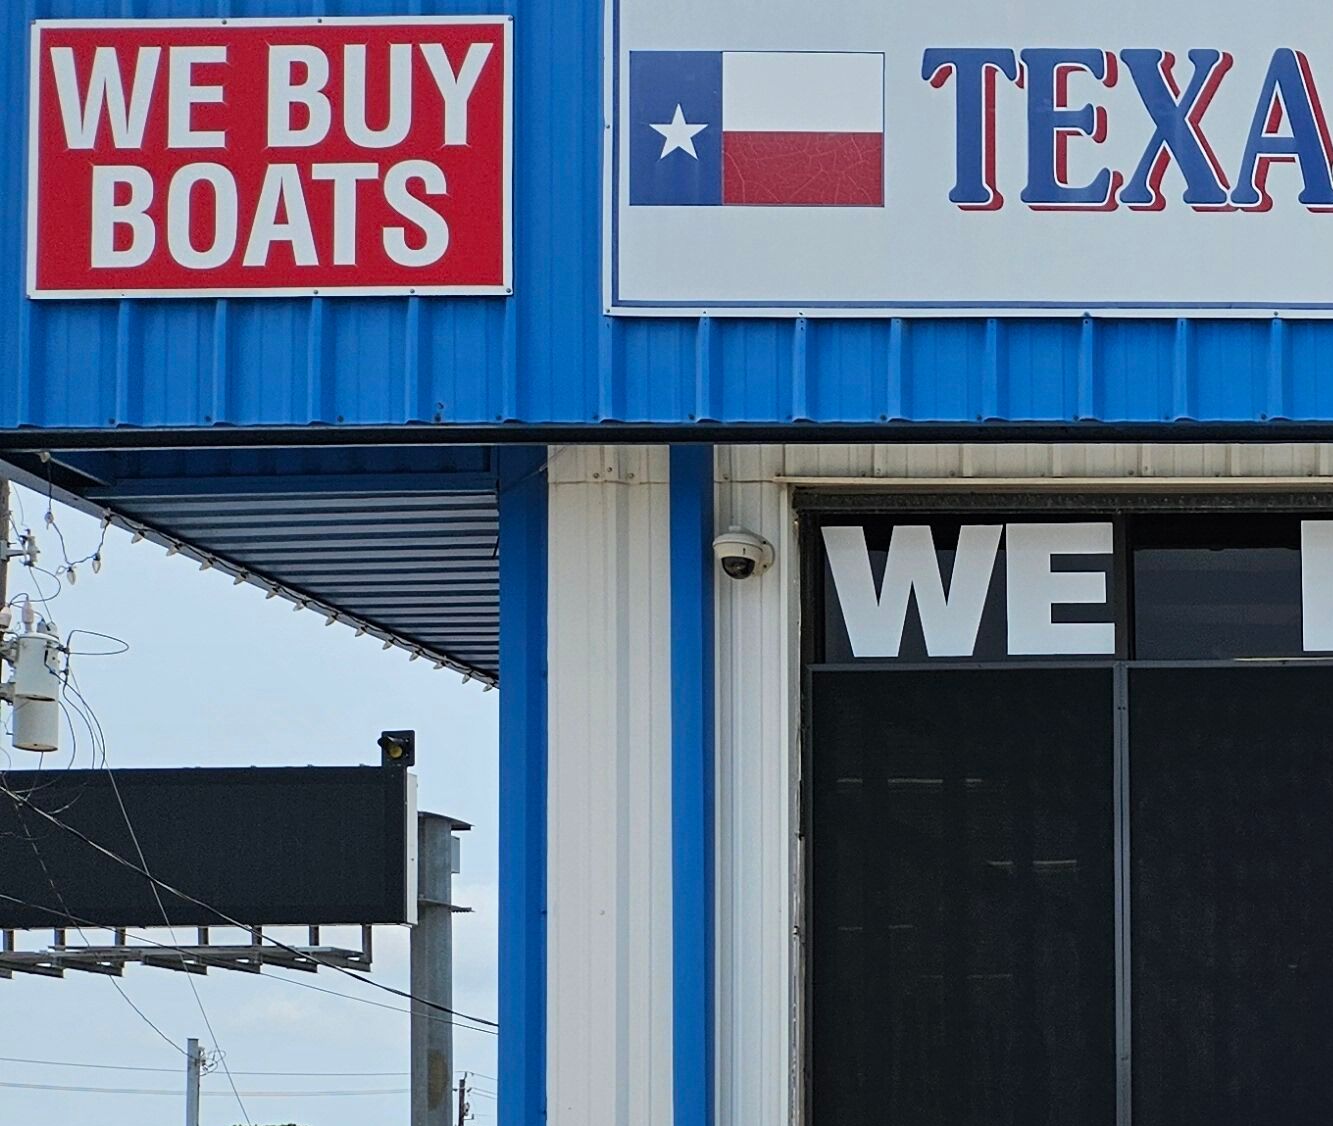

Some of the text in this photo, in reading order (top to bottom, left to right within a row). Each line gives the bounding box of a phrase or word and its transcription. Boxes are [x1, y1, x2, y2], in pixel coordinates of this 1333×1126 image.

[50, 42, 494, 150] WE BUY
[90, 159, 450, 270] BOATS
[820, 521, 1116, 658] WE
